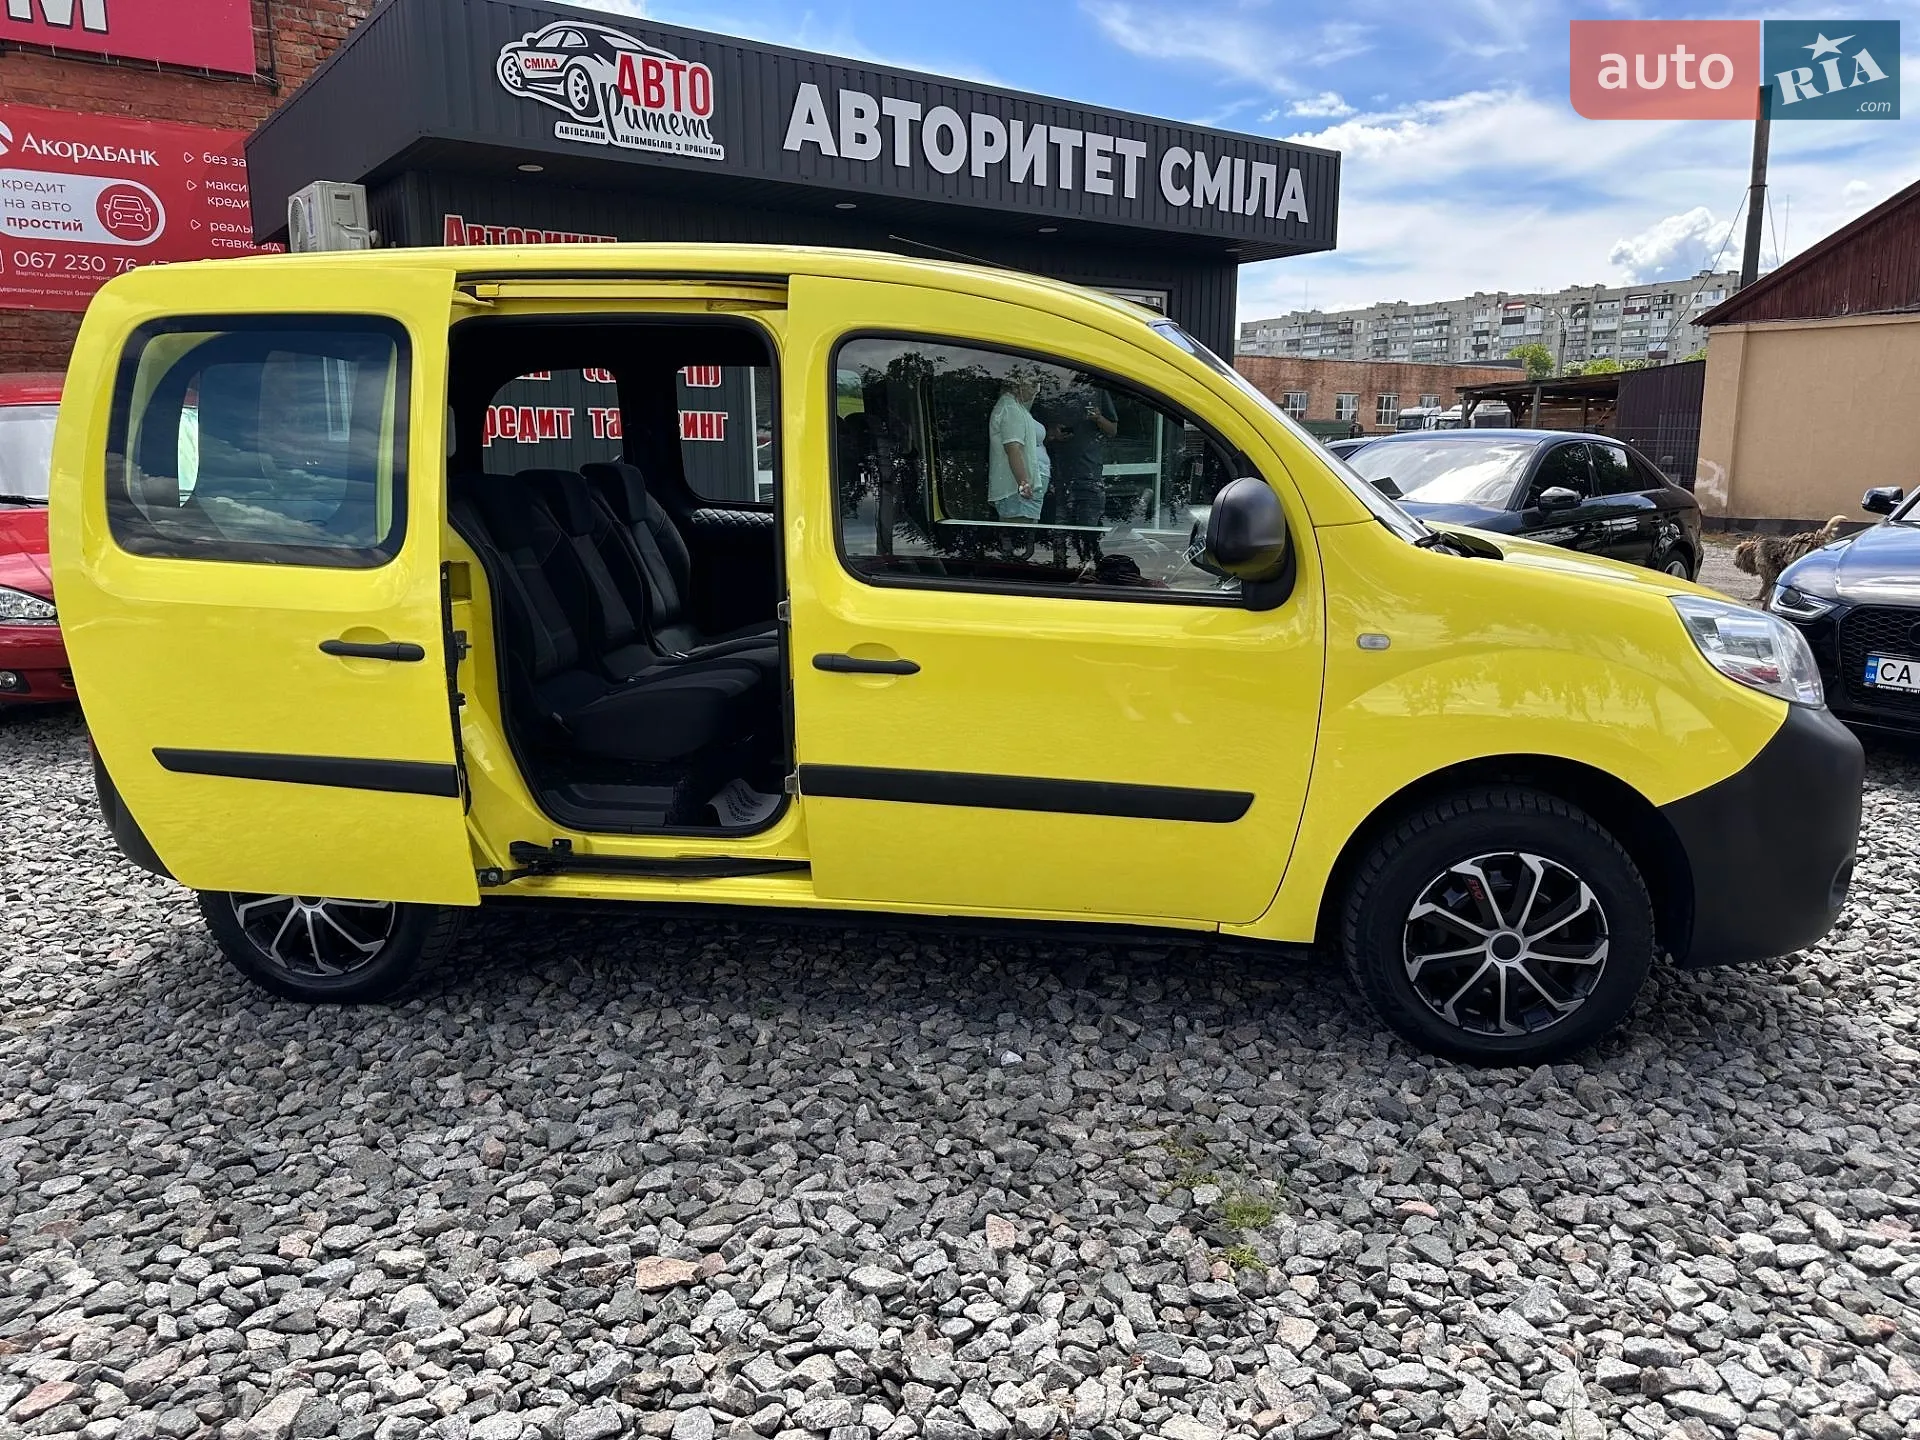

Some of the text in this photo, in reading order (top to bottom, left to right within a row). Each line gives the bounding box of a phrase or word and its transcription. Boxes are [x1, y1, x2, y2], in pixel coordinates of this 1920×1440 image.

[524, 57, 559, 70] СМІЛА
[616, 50, 712, 117] АВТО
[559, 125, 606, 140] АВТОСАЛОН
[620, 134, 673, 150] АВТОМОБІЛІВ
[684, 143, 721, 156] ПРОБІГОМ
[783, 82, 1309, 223] АВТОРИТЕТ СМІЛА
[203, 151, 247, 167] без за
[1, 178, 66, 194] кредит
[206, 181, 249, 193] макси
[4, 198, 72, 213] на авто
[207, 196, 250, 209] креди
[6, 216, 83, 232] простий
[13, 250, 57, 269] 067
[64, 254, 106, 273] 230
[112, 257, 137, 273] 76
[482, 405, 574, 447] редит
[677, 410, 729, 442] инг
